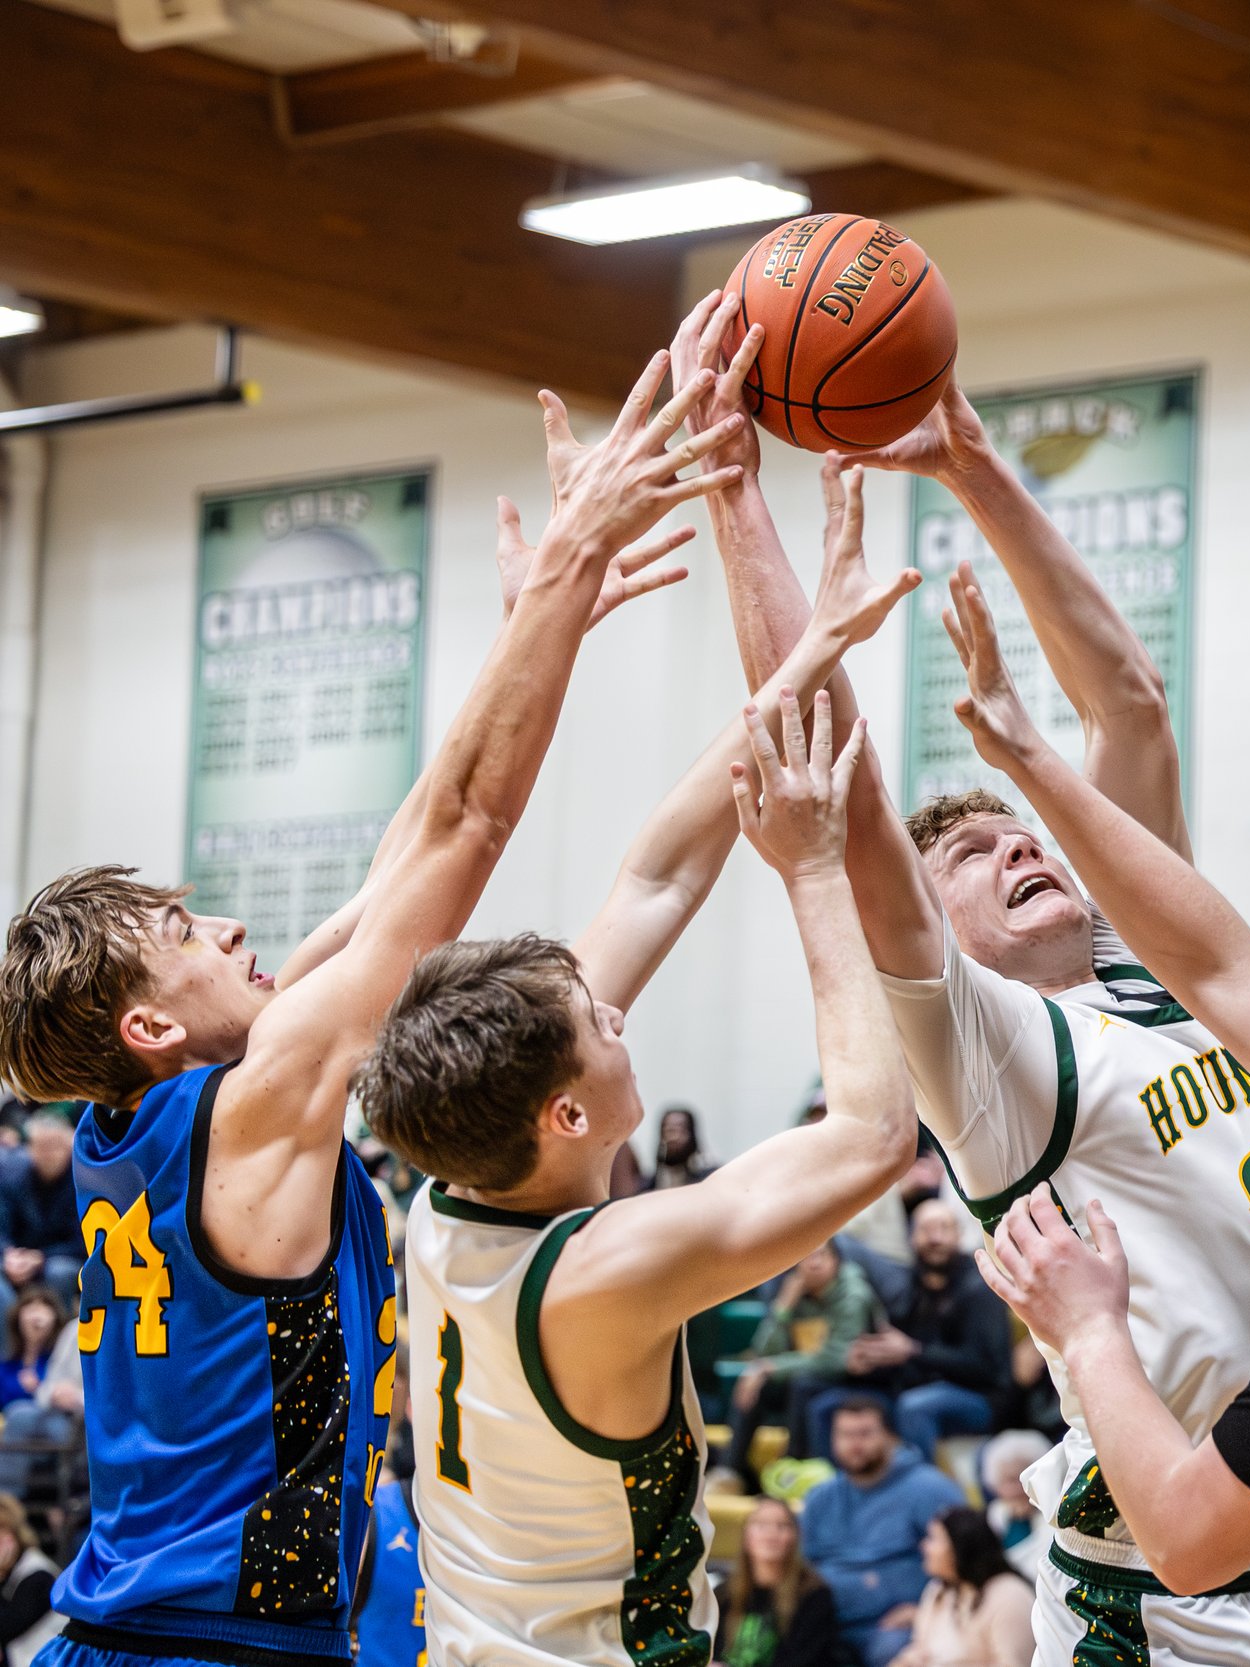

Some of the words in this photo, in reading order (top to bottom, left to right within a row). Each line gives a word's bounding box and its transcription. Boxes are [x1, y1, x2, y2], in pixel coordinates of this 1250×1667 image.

[815, 223, 912, 327] PALDING
[77, 1189, 174, 1358] 24
[435, 1308, 473, 1495] 1
